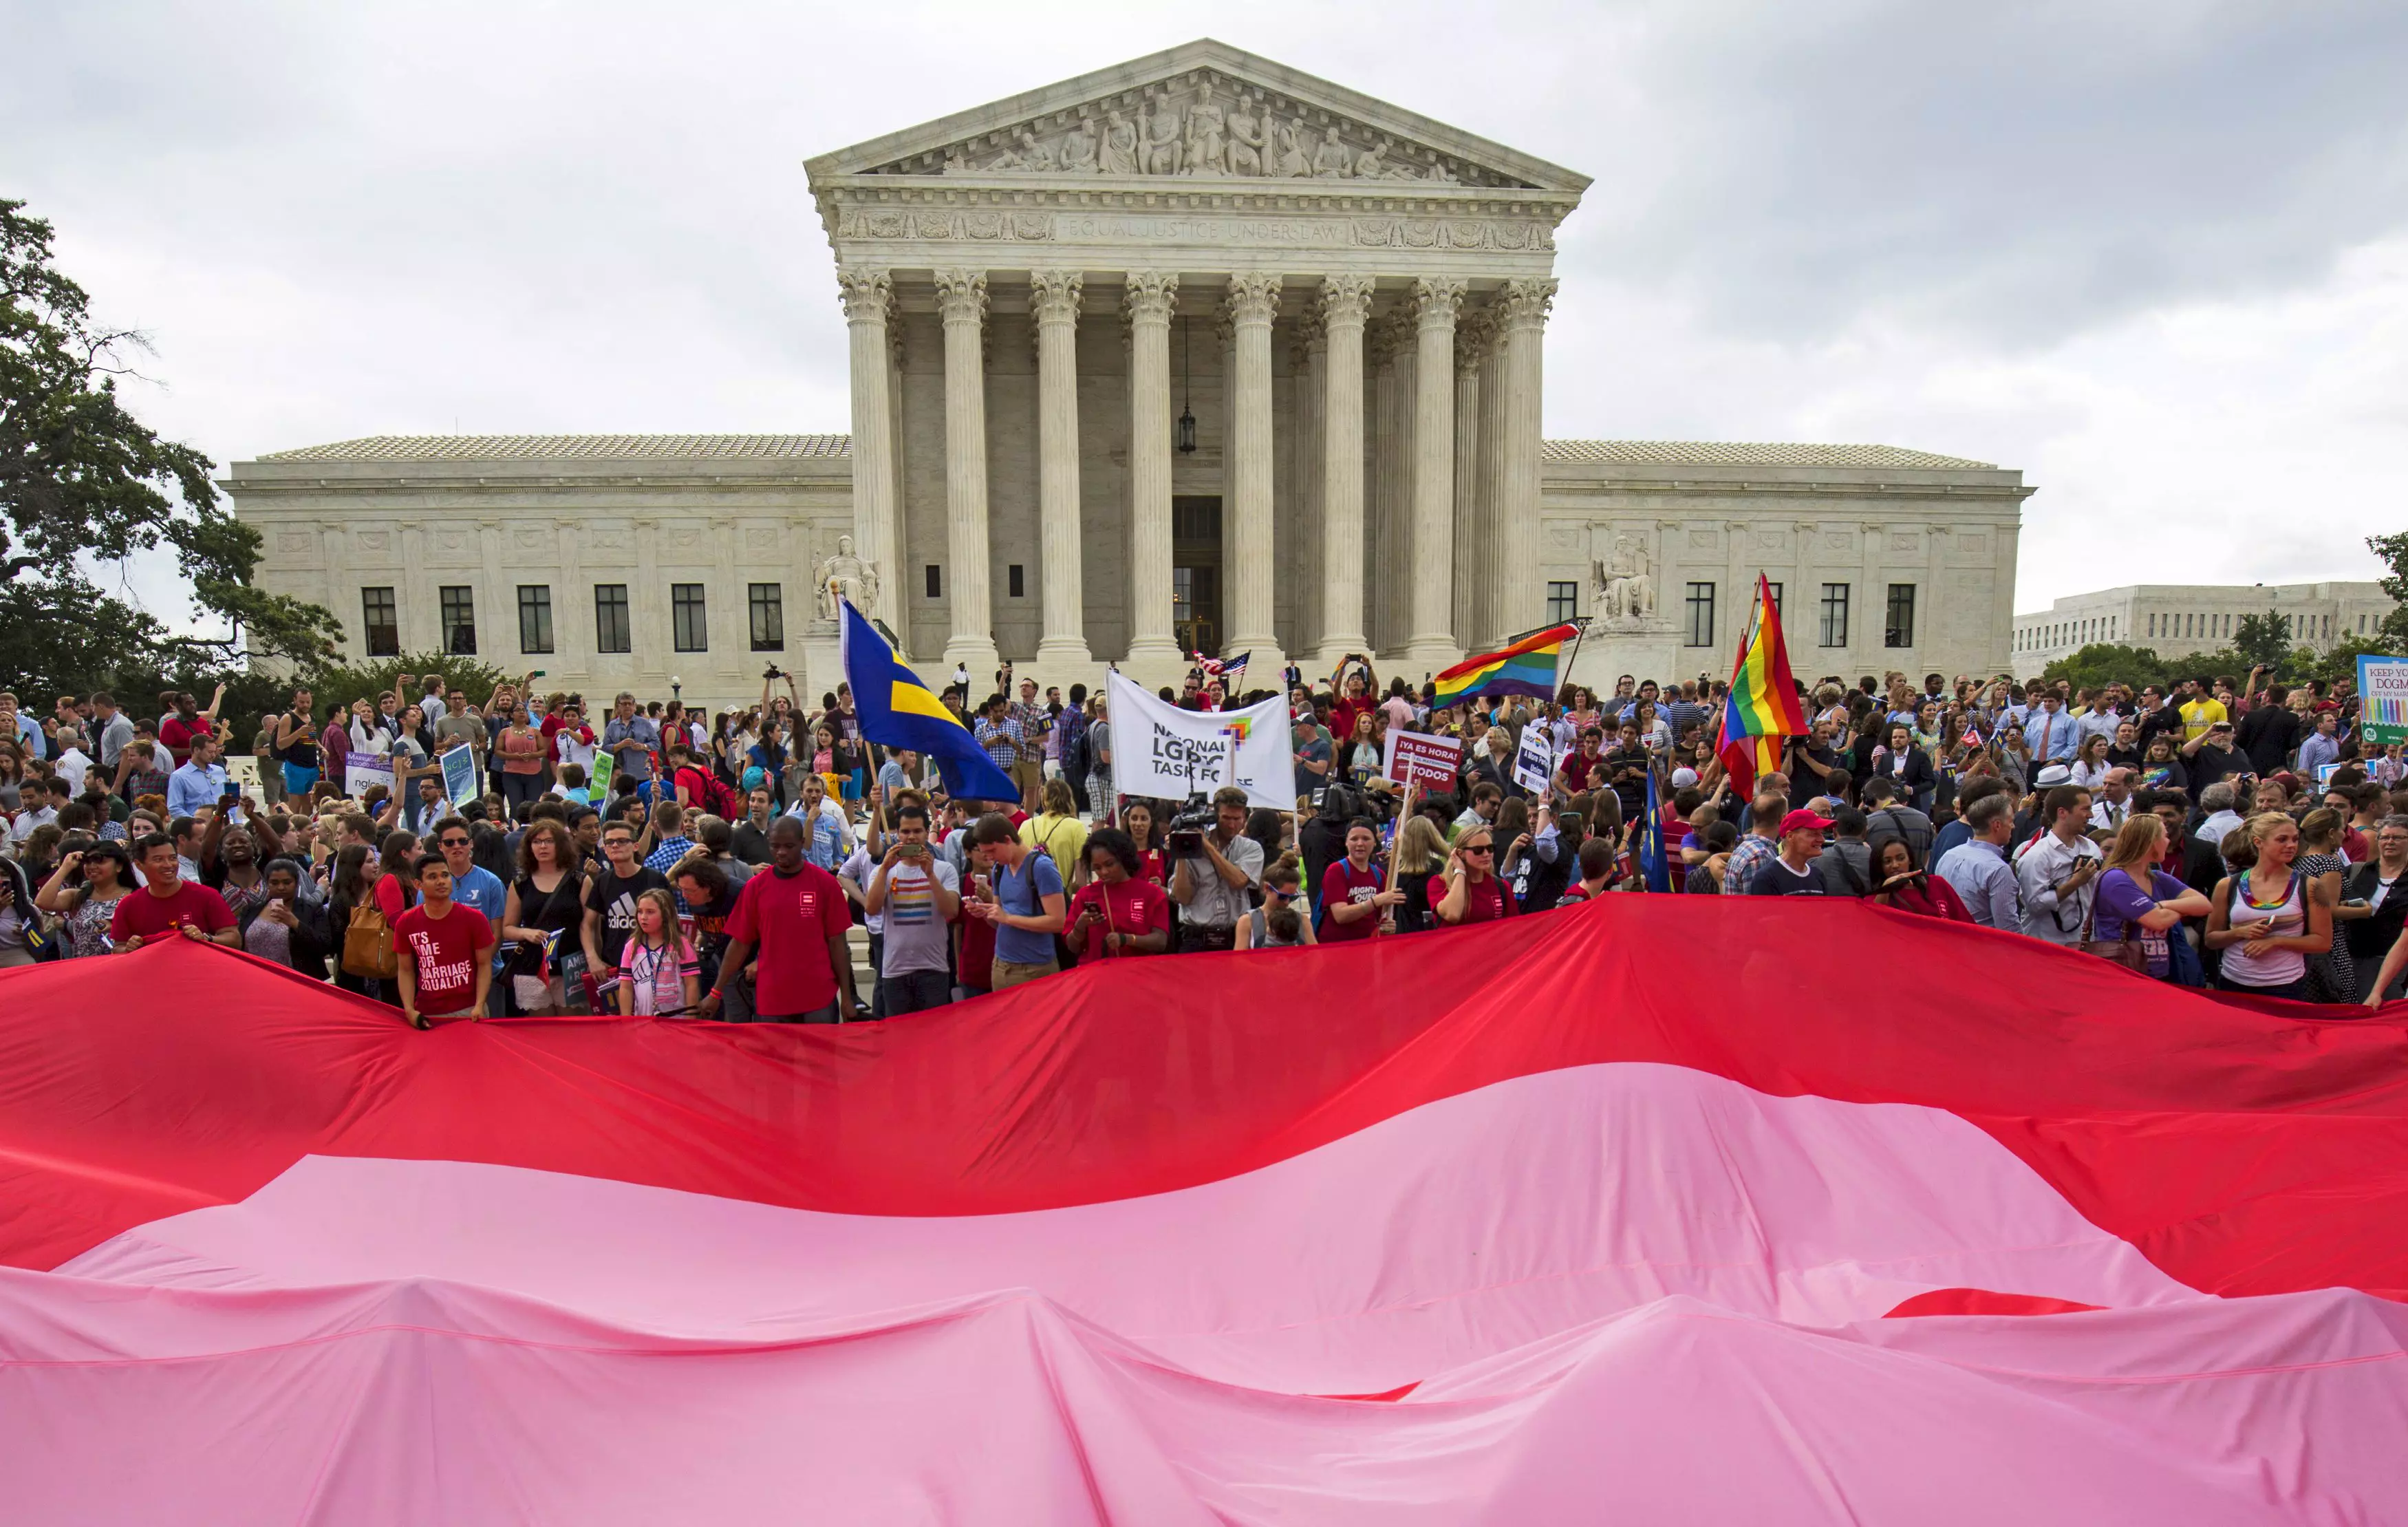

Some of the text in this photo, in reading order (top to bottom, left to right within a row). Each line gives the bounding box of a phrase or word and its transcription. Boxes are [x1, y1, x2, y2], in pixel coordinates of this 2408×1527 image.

[1068, 220, 1337, 241] EQUAL JUSTICE UNDER LAW
[2370, 668, 2394, 676] KEEP
[347, 753, 378, 763] MARRIAG
[1415, 745, 1427, 754] ES
[1428, 747, 1458, 760] HORA!
[1152, 760, 1253, 786] TASK FOCE
[1412, 765, 1449, 782] TODOS
[409, 931, 429, 946] IT'S
